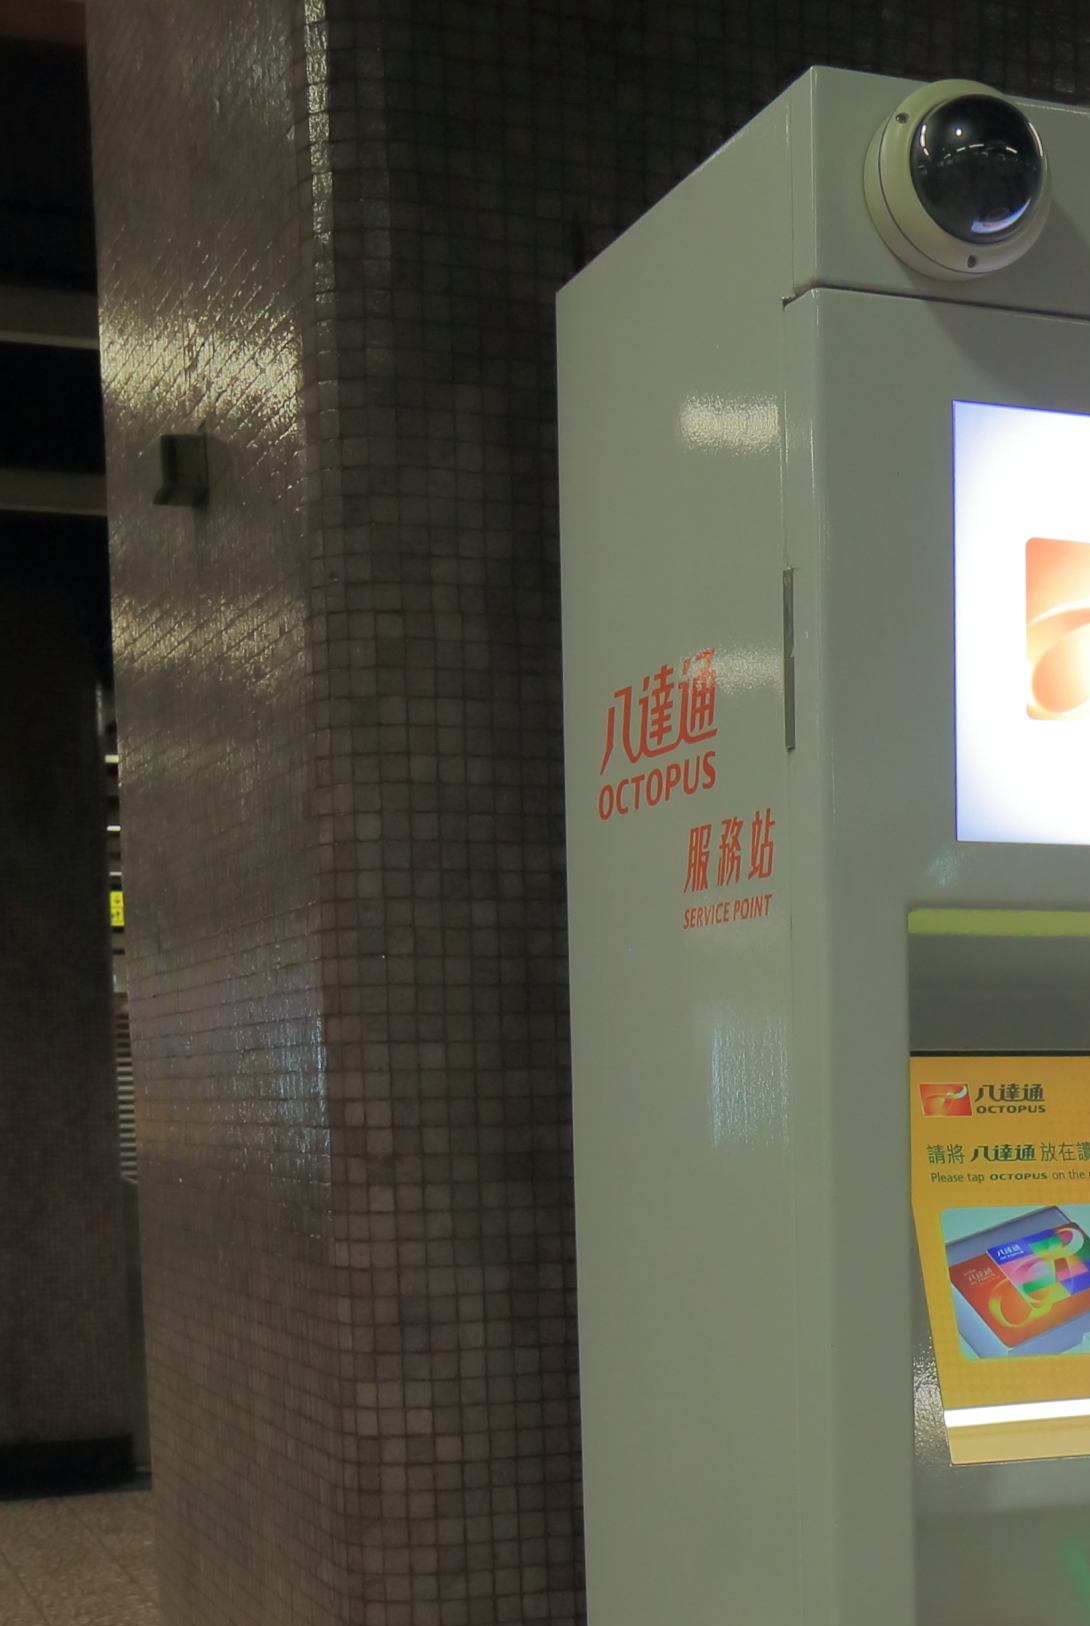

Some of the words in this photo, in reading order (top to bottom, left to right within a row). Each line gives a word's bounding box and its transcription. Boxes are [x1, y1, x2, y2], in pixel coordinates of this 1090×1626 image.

[599, 647, 718, 775] 八達通
[598, 750, 716, 821] OCTOPUS
[683, 807, 776, 894] 服務站
[683, 902, 731, 930] SERVICE
[733, 894, 773, 921] POINT
[975, 1083, 1045, 1102] 八達通
[976, 1105, 1047, 1115] OCTOPUS
[927, 1143, 966, 1165] 請將
[970, 1144, 1037, 1162] 八達通
[931, 1172, 968, 1183] Please
[968, 1173, 985, 1184] tap
[990, 1172, 1048, 1181] OCTOPUS
[1052, 1171, 1065, 1180] on
[1068, 1169, 1086, 1180] the
